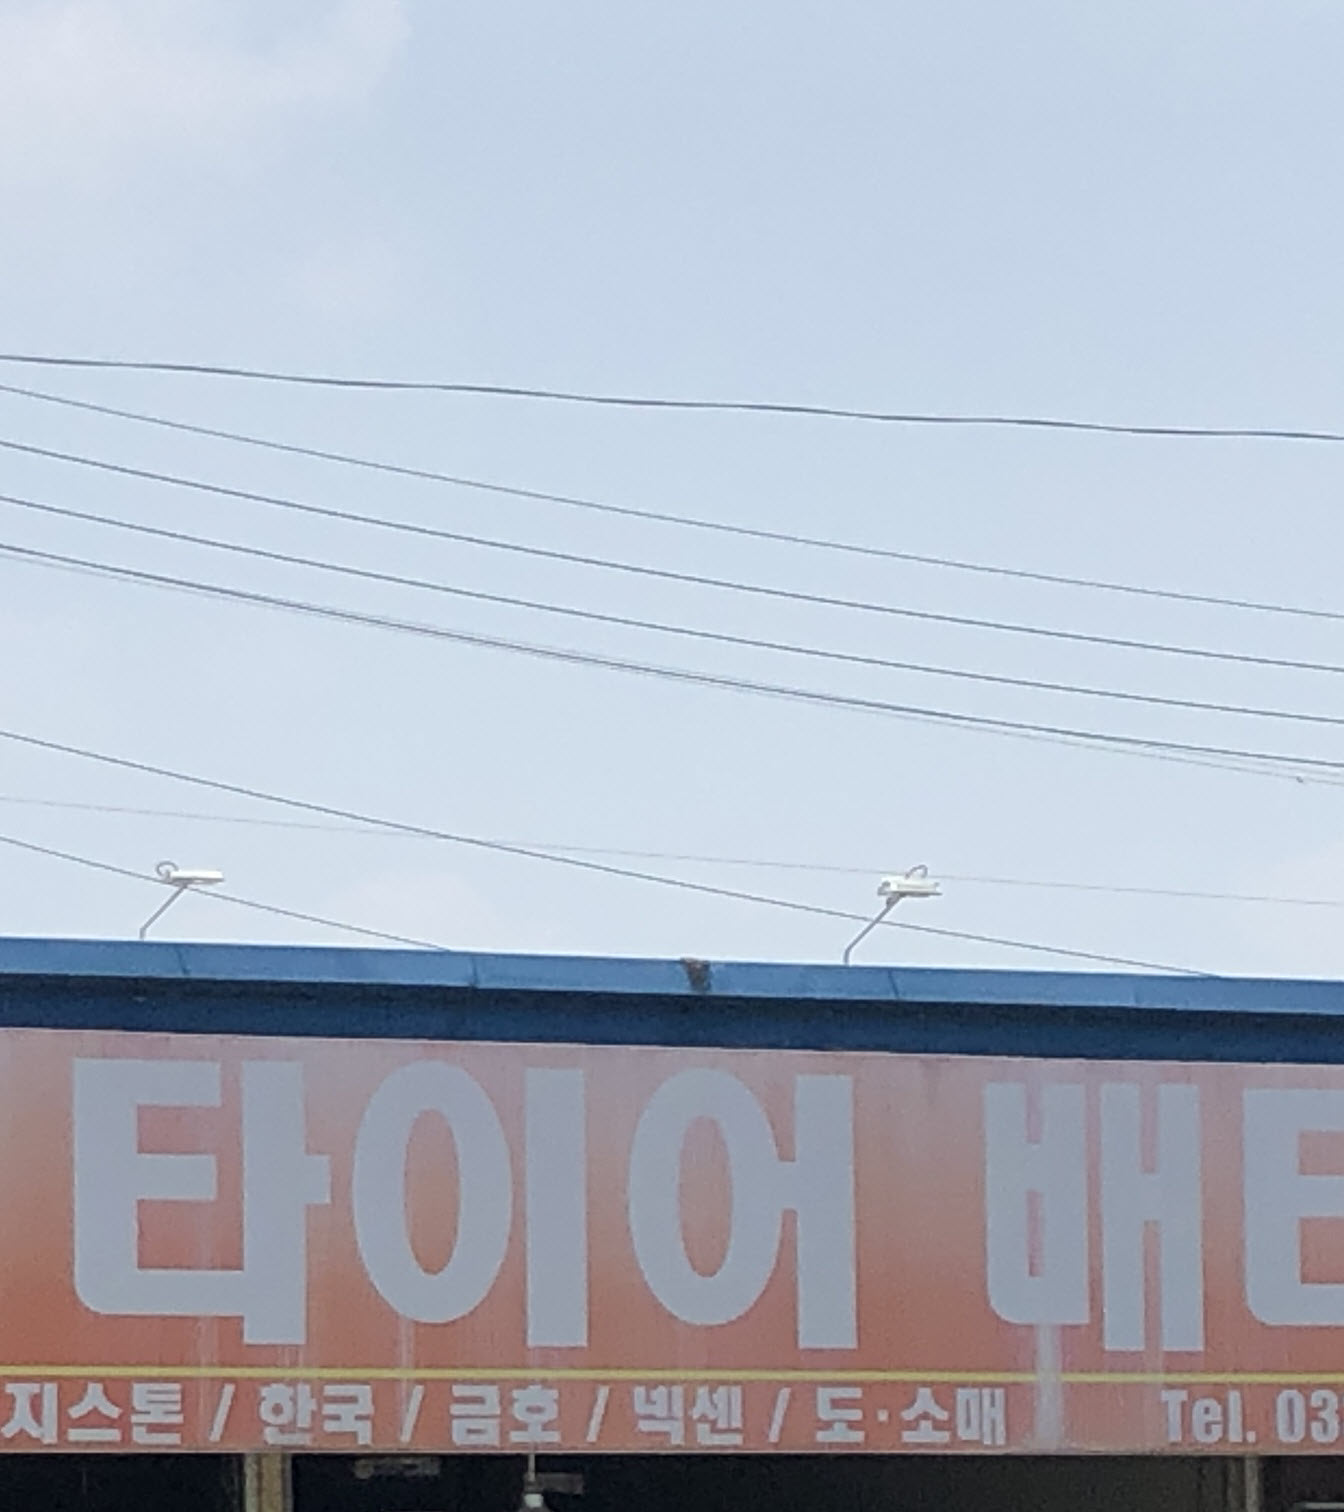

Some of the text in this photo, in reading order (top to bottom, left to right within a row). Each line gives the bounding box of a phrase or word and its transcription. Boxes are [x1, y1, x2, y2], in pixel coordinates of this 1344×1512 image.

[73, 1057, 858, 1350] 타이어
[258, 1382, 374, 1446] 한국
[450, 1384, 561, 1446] 금호
[633, 1385, 744, 1446] 넥센
[1162, 1389, 1256, 1443] Tel.
